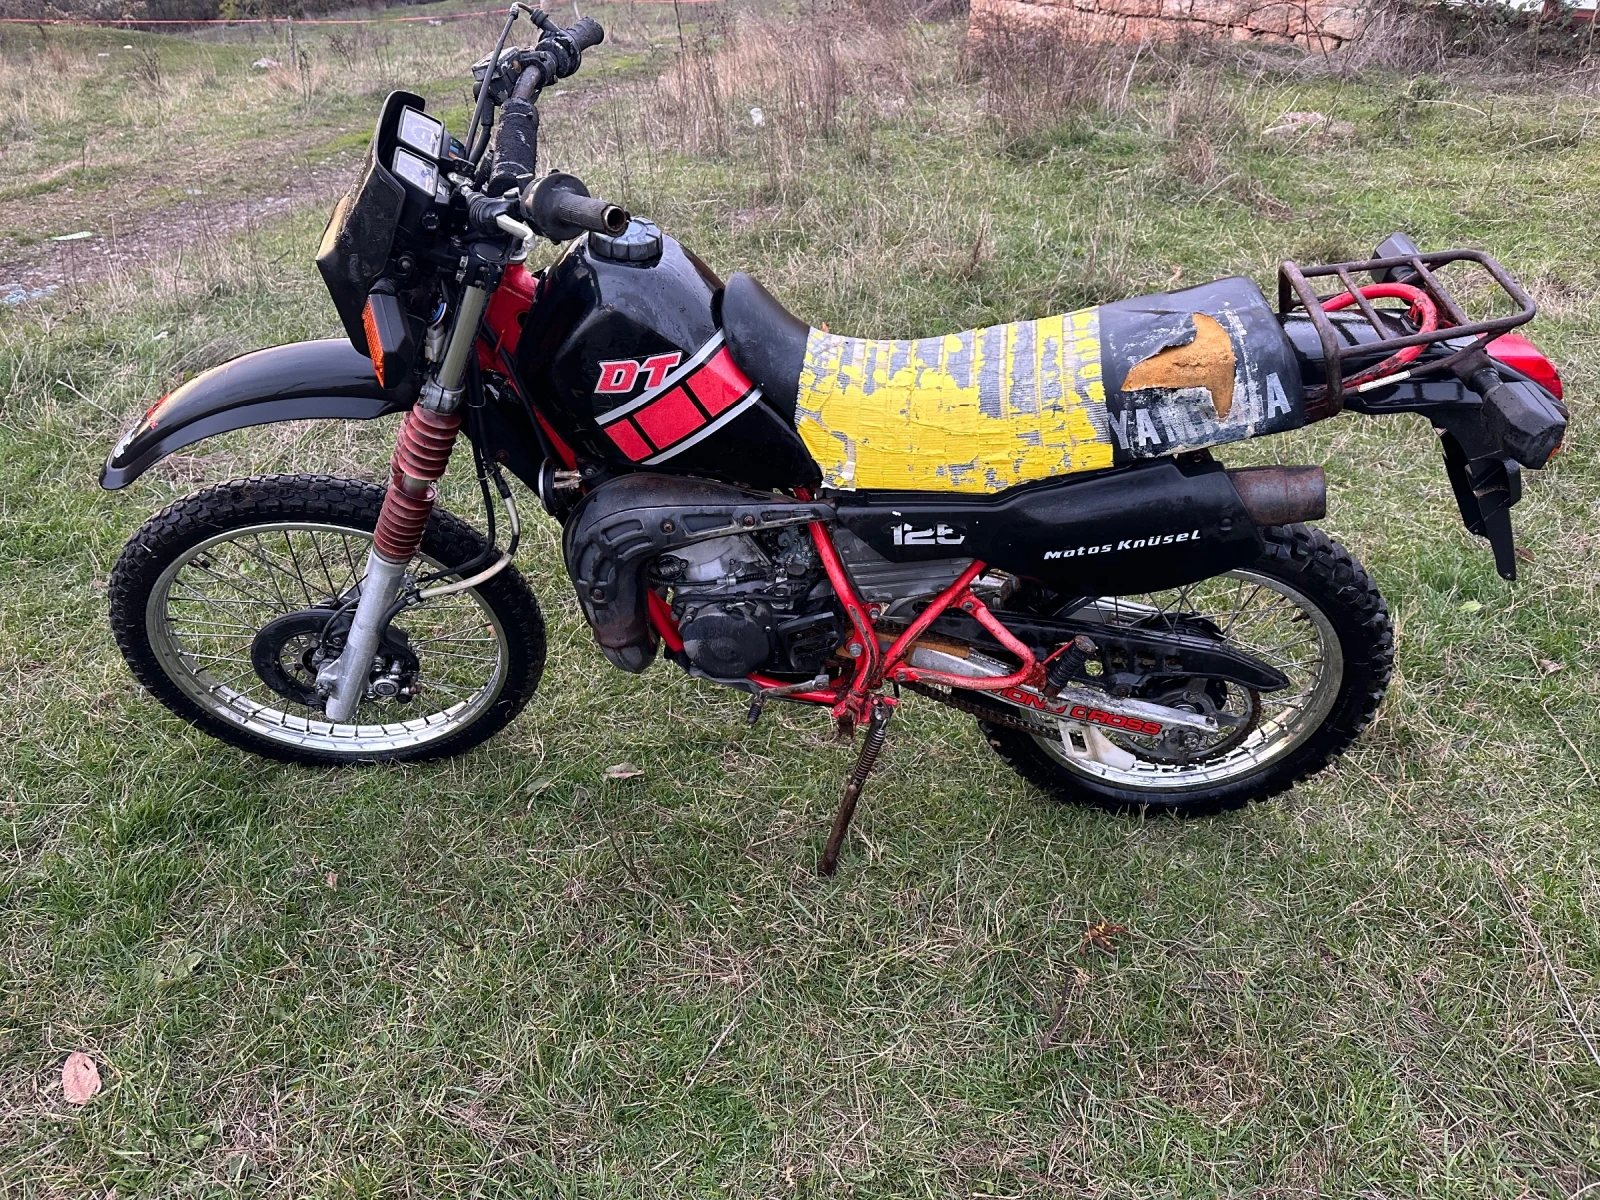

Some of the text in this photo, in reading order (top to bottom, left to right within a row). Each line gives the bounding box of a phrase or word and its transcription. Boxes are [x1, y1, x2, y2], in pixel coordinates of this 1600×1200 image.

[594, 351, 682, 393] DT
[891, 522, 965, 545] 125
[1070, 705, 1163, 736] CROSS
